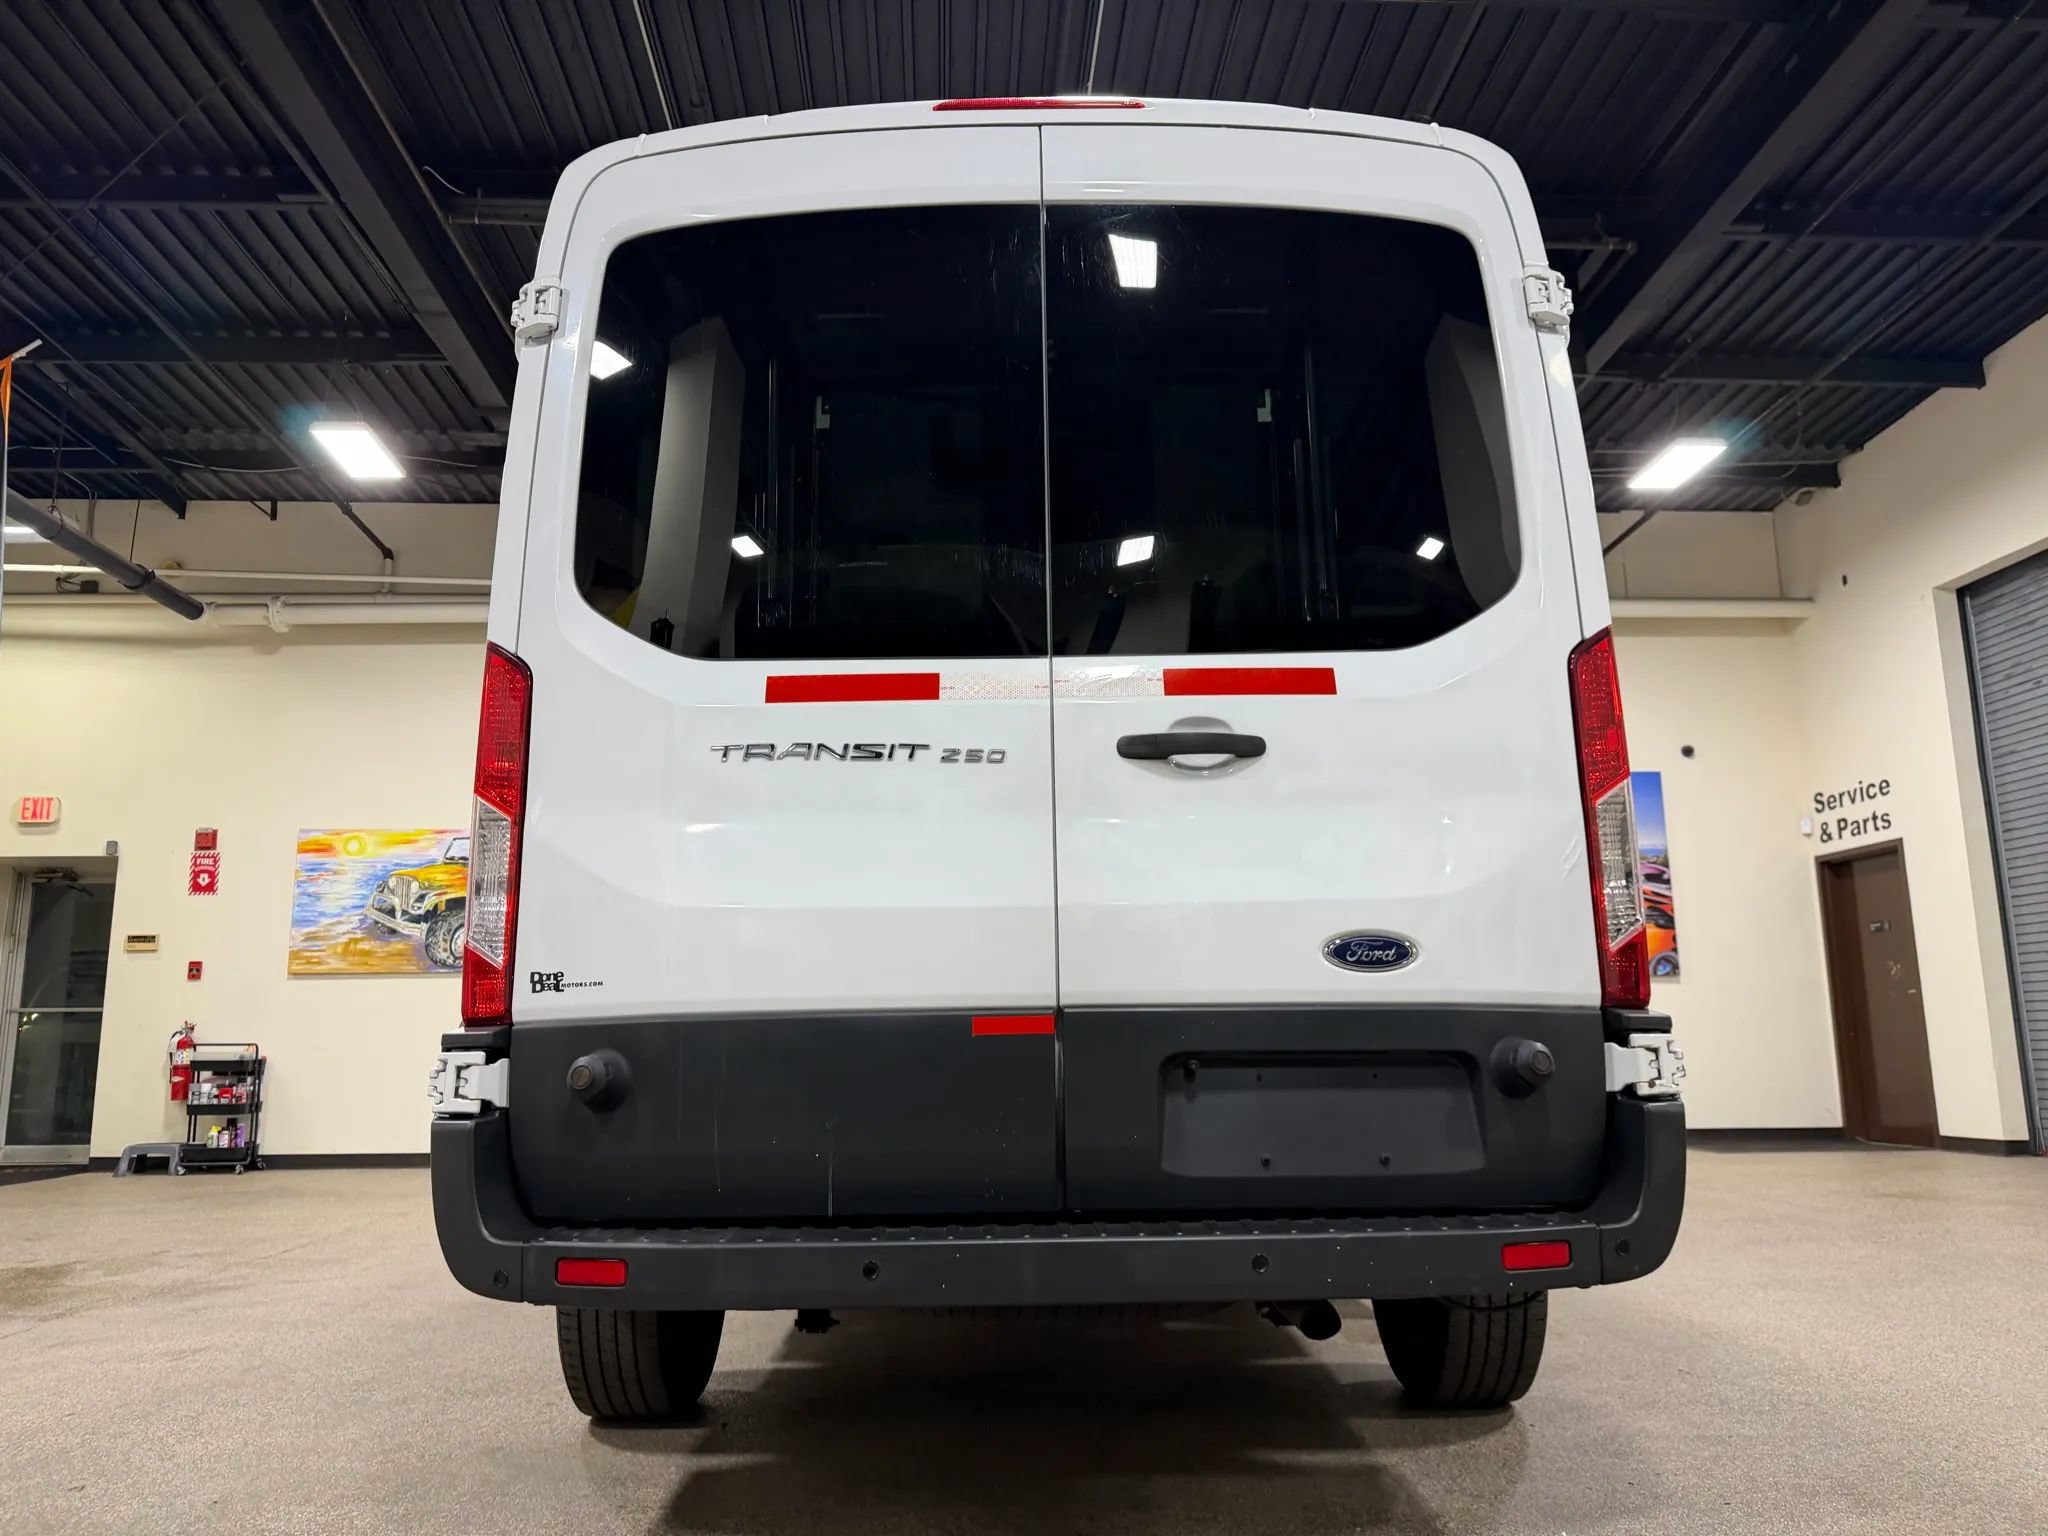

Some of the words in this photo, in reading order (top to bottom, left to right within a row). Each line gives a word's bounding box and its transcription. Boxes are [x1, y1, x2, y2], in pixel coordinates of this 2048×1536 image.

[710, 743, 930, 762] TRANSIT
[940, 748, 1006, 764] 250
[1814, 779, 1891, 813] Service
[21, 797, 54, 820] EXIT
[1820, 821, 1833, 844] &
[1837, 810, 1892, 840] Parts
[196, 857, 215, 865] FIRE
[1346, 940, 1397, 961] Ford
[530, 971, 564, 983] Done
